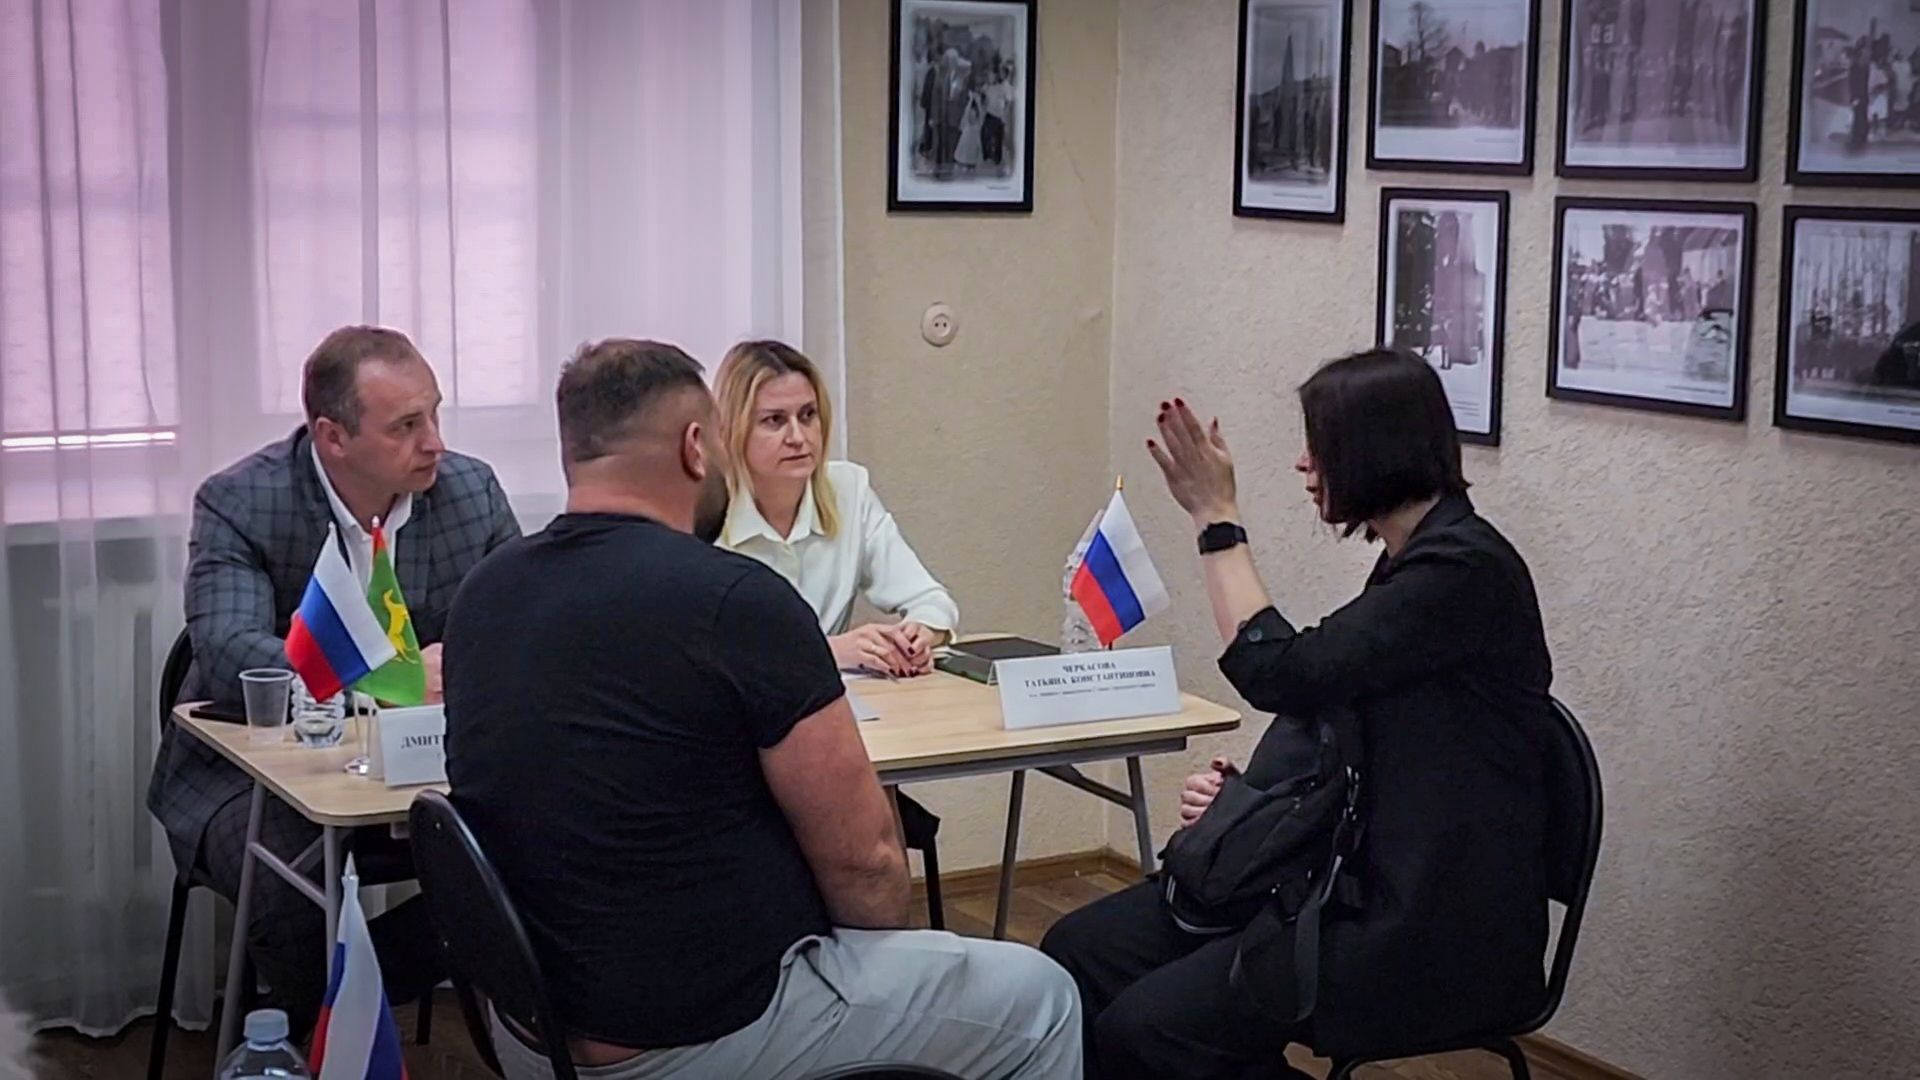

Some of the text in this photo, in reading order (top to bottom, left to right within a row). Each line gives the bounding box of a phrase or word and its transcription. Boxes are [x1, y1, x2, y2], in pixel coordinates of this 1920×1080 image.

[1062, 662, 1116, 673] ЧЕРКАСОВА
[1024, 670, 1156, 688] ТАТЬЯНА КОНСТАНТИНОВНА
[401, 734, 441, 749] ДМИТ
